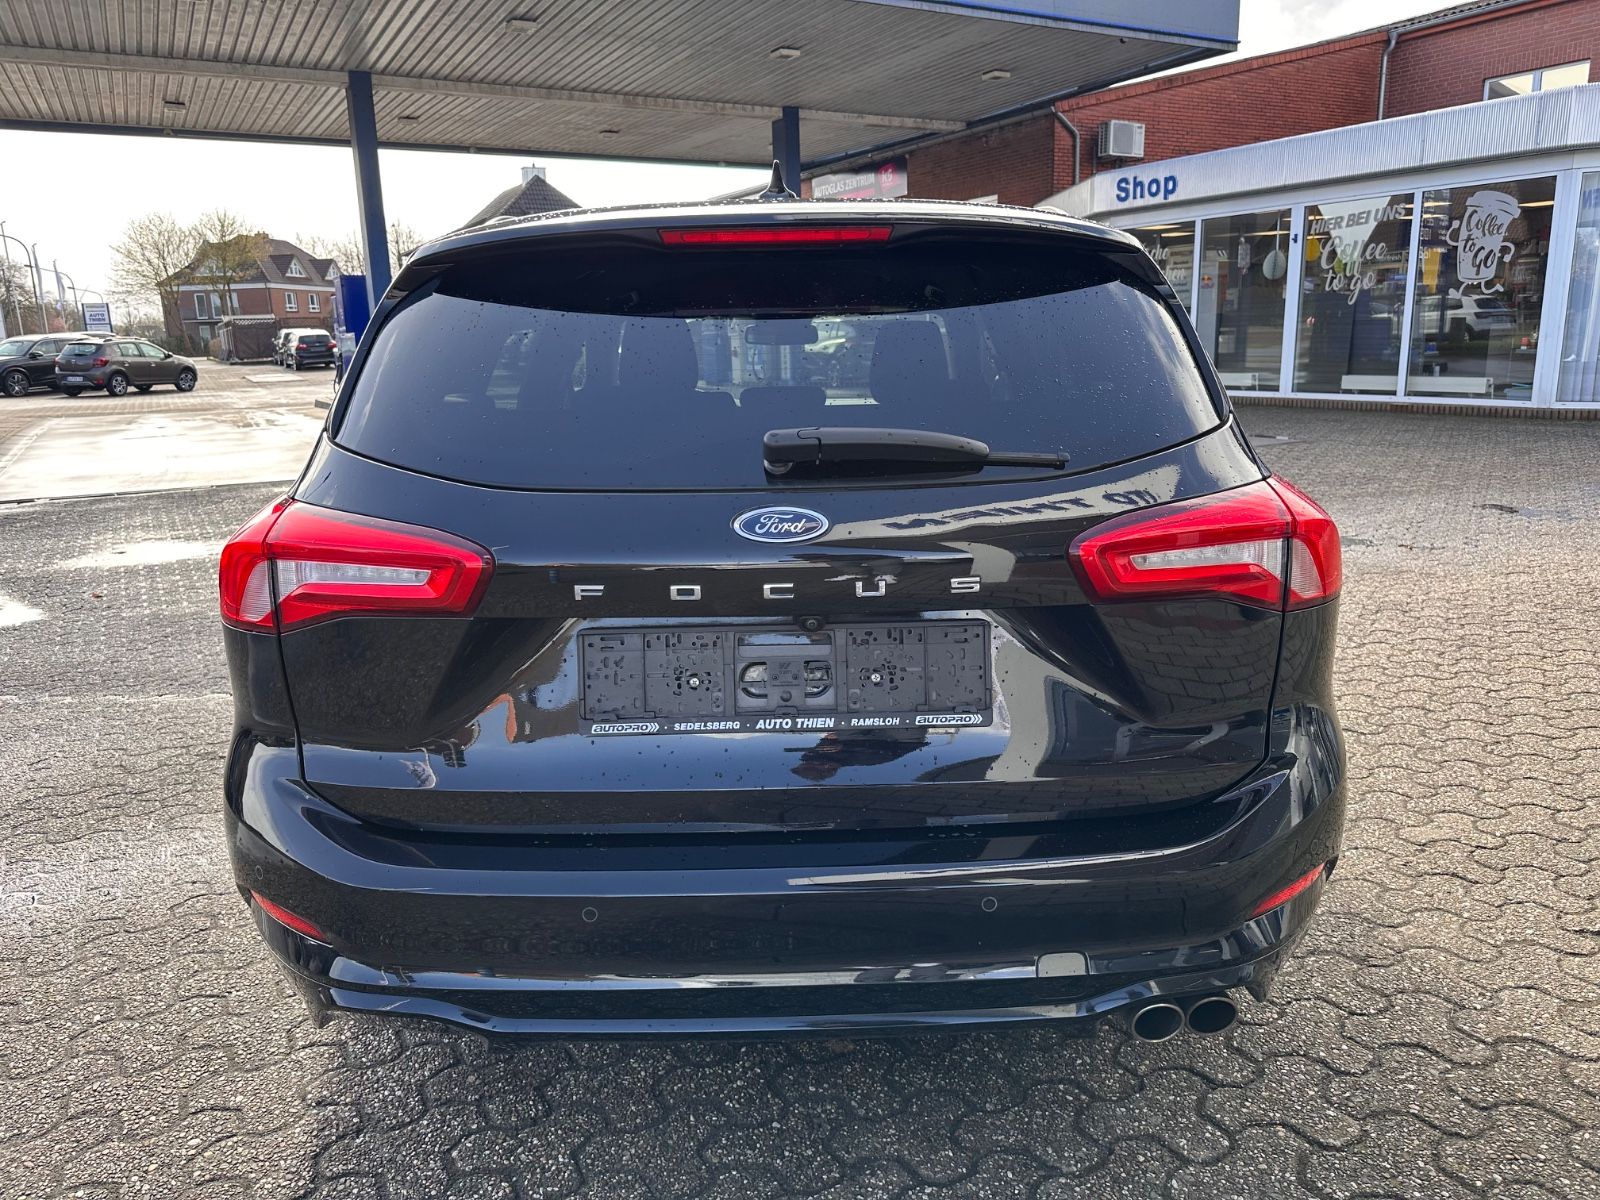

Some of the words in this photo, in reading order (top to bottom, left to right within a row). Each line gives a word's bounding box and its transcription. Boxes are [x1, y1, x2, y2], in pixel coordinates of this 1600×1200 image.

[814, 180, 845, 198] AUTOGLAS
[845, 172, 875, 190] ZENTRUM
[1116, 175, 1178, 202] Shop
[1311, 215, 1345, 234] HIER
[1345, 210, 1373, 228] BEI
[1373, 202, 1407, 223] UNS
[1466, 209, 1505, 237] Coffee
[1320, 235, 1388, 277] Coffee
[1461, 234, 1477, 253] to
[1324, 269, 1345, 291] to
[1349, 272, 1377, 305] go
[755, 513, 806, 534] Ford
[574, 576, 981, 601] FOCUS
[674, 721, 740, 731] SEDELSBERG
[756, 718, 792, 730] AUTO
[796, 717, 834, 728] THIEN
[851, 717, 900, 727] RAMSLOH
